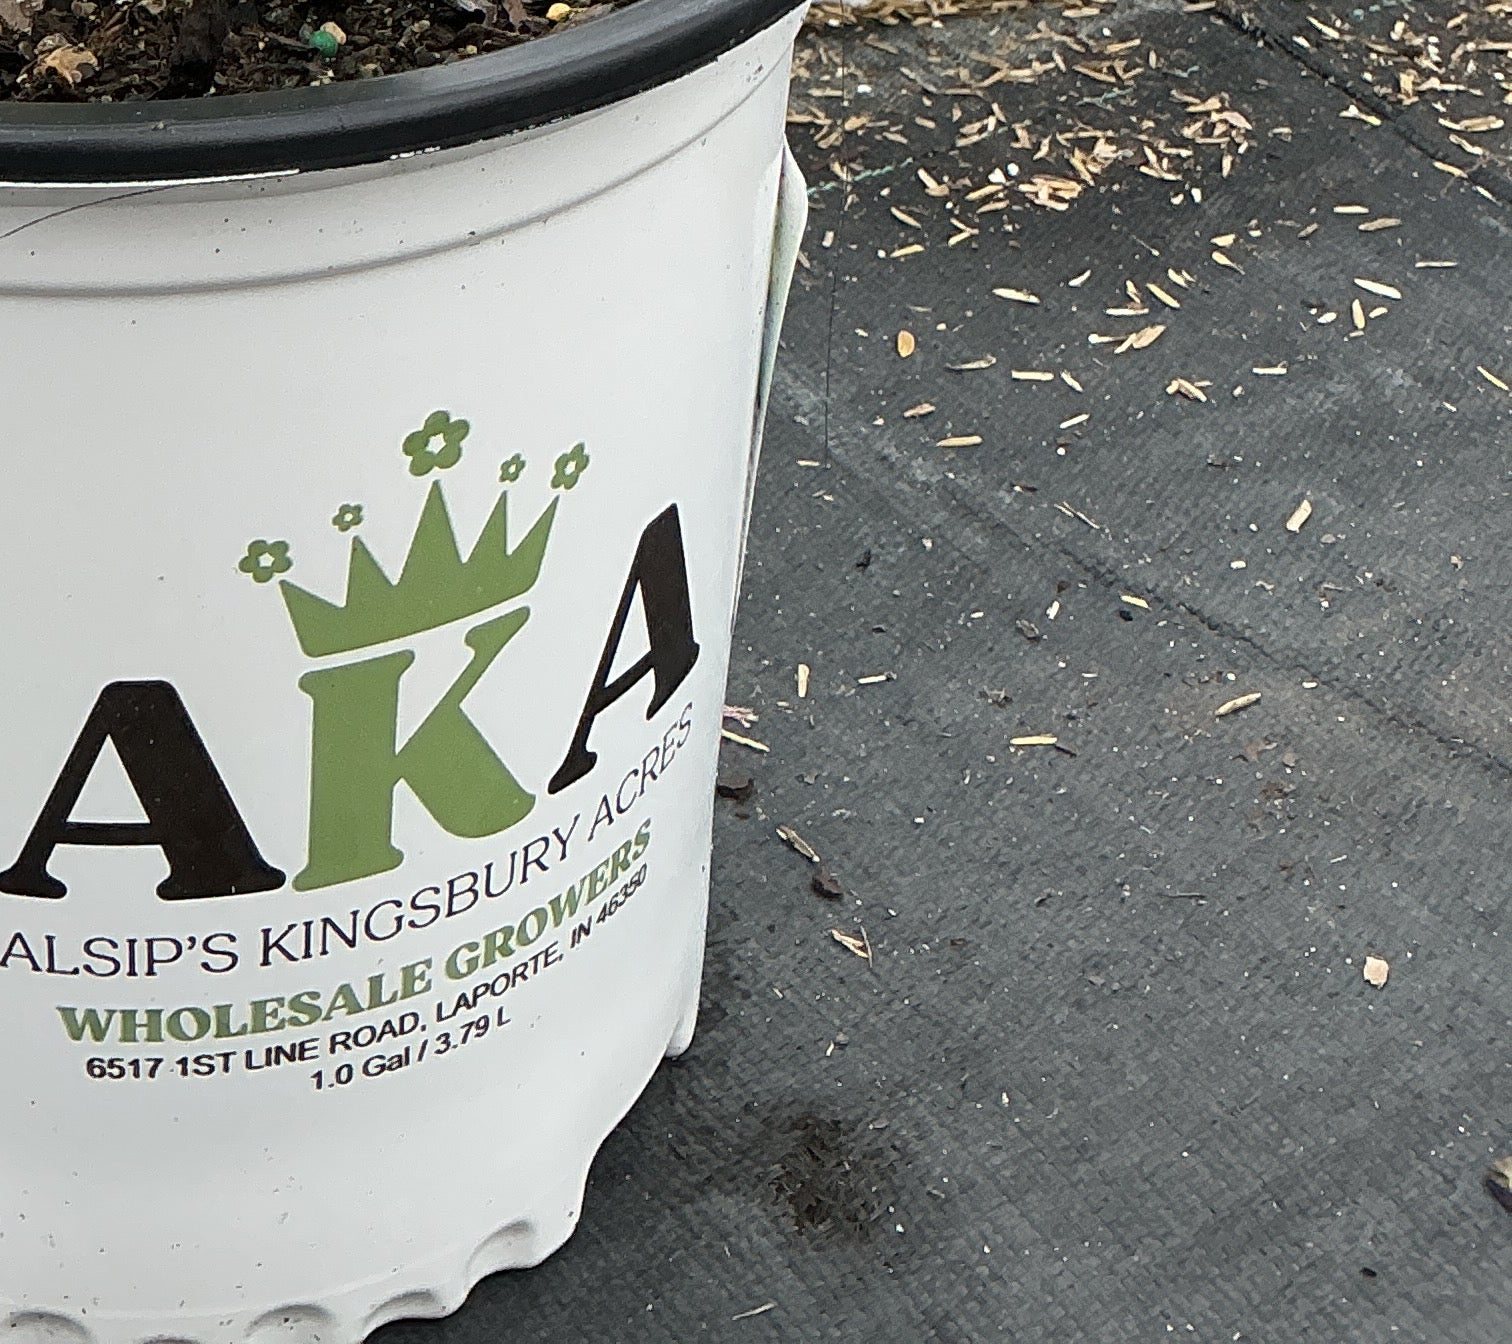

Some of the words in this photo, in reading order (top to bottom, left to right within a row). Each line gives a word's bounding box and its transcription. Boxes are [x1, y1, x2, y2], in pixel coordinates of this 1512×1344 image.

[55, 957, 433, 1044] WHOLESALE
[444, 817, 651, 981] GROWERS
[259, 812, 581, 968] KINGSBURY
[587, 700, 693, 843] ACRES
[87, 1056, 164, 1080] 6517
[175, 1051, 237, 1078] 1ST
[245, 1037, 320, 1071] LINE
[436, 940, 564, 1022] LAPORTE,
[570, 915, 592, 949] IN
[595, 862, 648, 925] 46350
[311, 1063, 354, 1091] 1.0
[362, 1046, 410, 1077] Gal
[434, 1014, 489, 1055] 3.79
[498, 1005, 512, 1026] L
